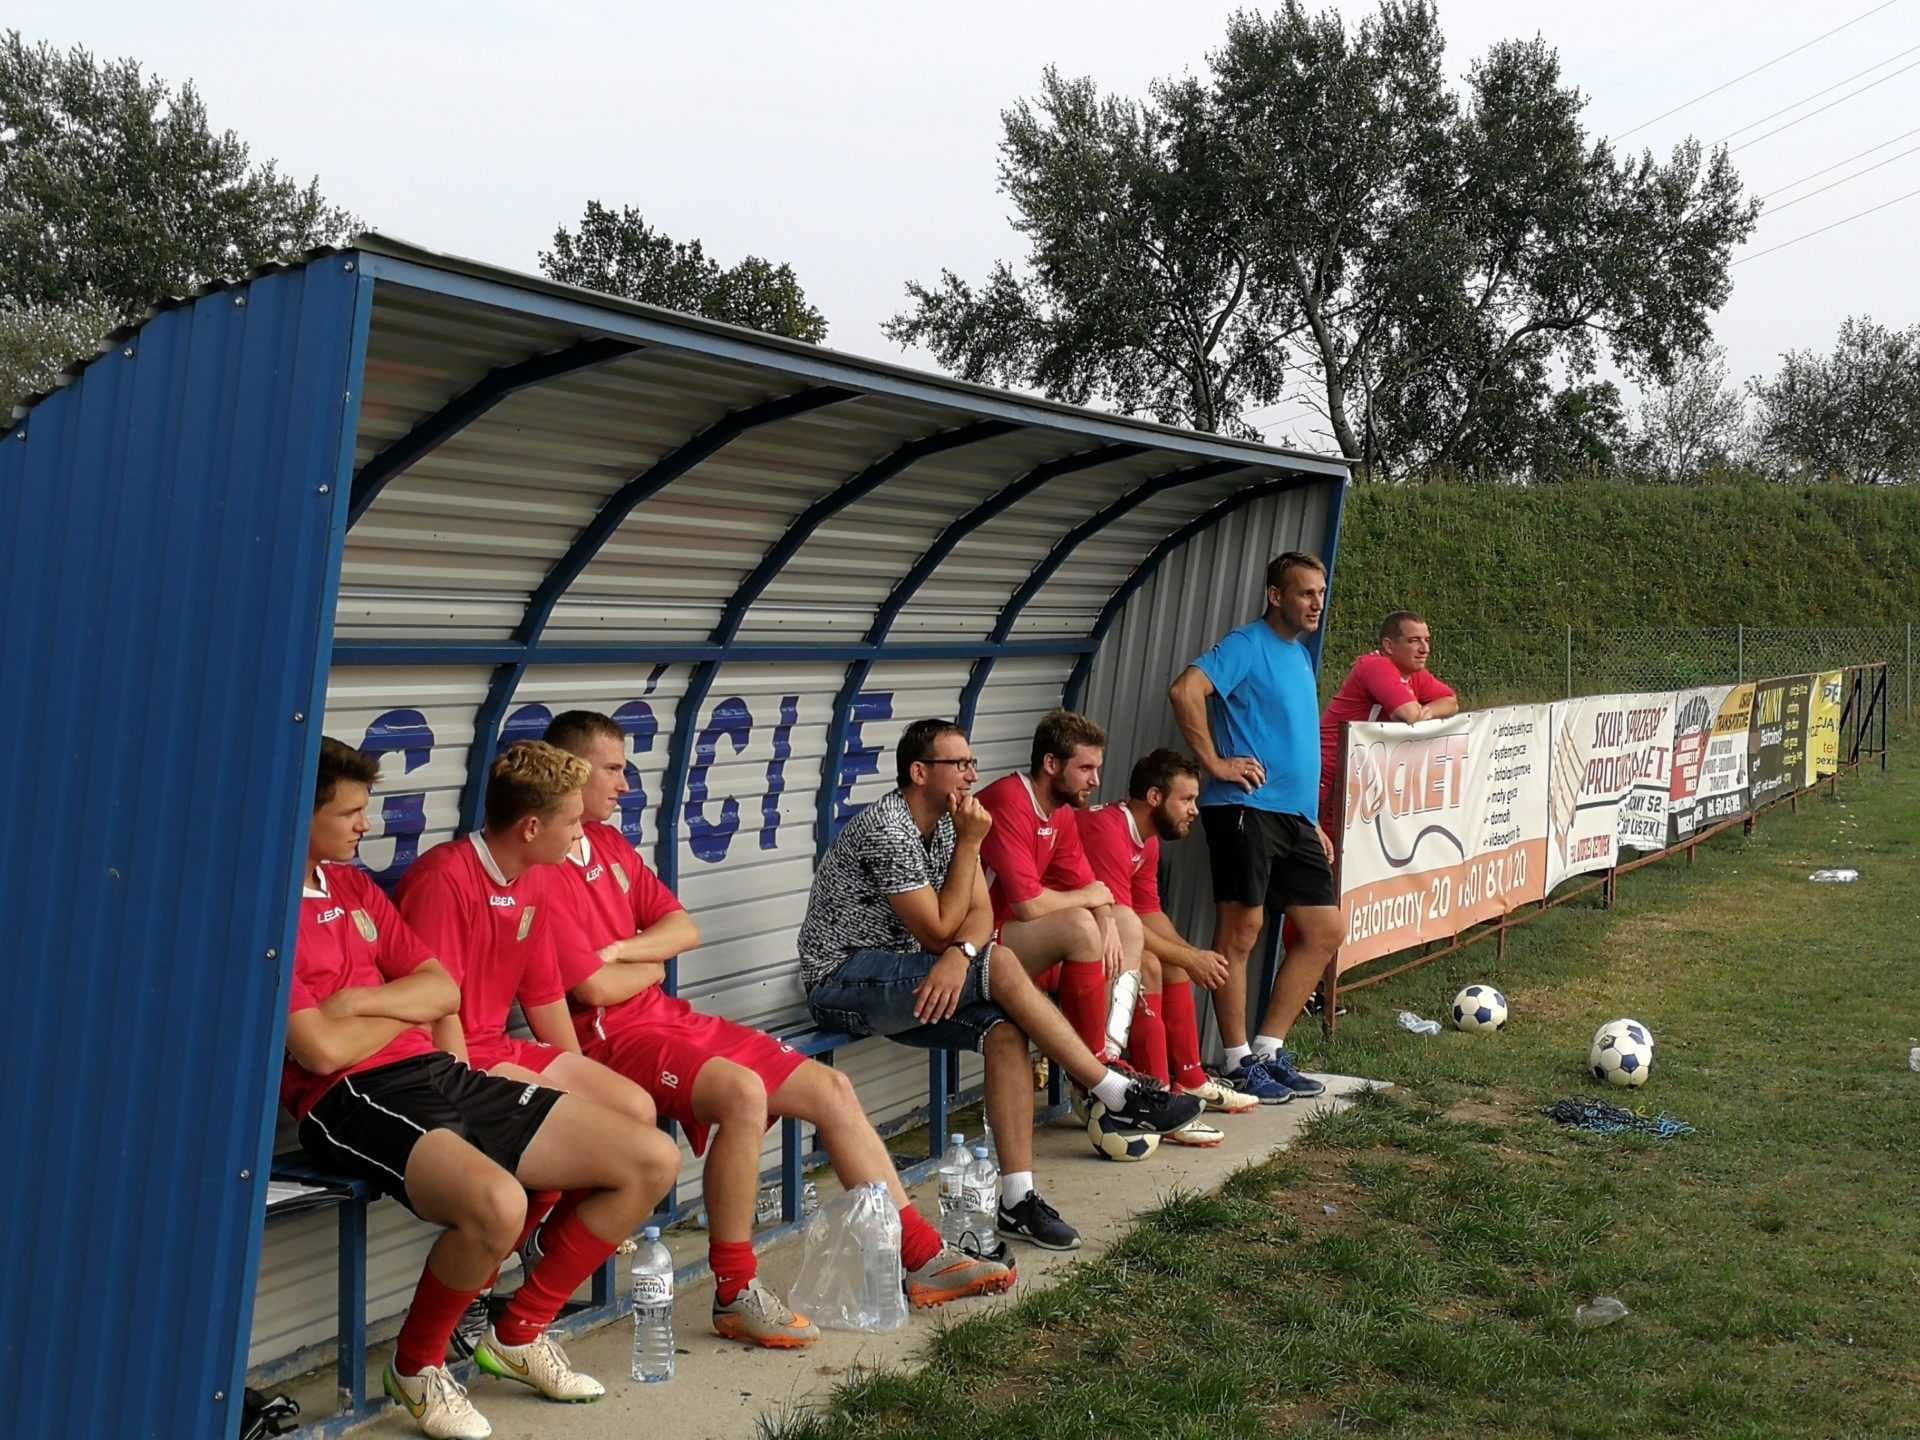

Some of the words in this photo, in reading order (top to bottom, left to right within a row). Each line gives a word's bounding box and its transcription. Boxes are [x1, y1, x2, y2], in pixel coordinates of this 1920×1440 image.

[1647, 795, 1663, 813] 52
[1630, 818, 1660, 838] LISZKI
[1347, 888, 1426, 944] Jeziorzany
[1428, 876, 1451, 920] 20
[660, 1070, 679, 1090] 18
